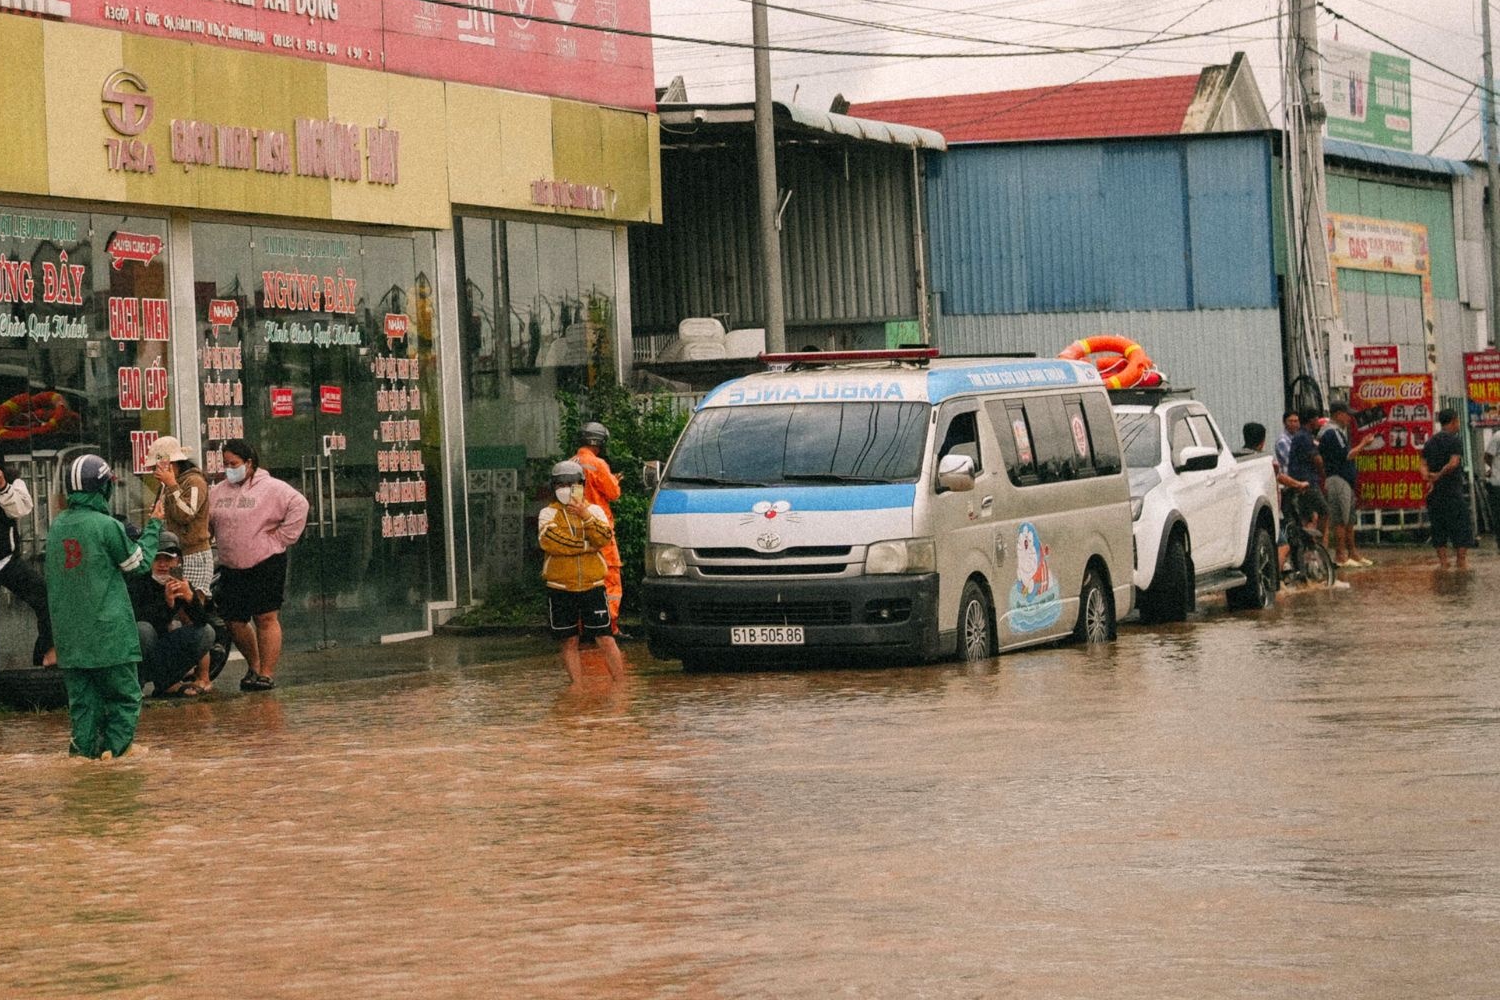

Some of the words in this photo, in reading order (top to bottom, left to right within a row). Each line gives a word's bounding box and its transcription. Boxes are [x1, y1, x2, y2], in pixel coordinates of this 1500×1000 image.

[104, 137, 156, 174] TASA
[1349, 237, 1368, 259] GAS
[42, 249, 85, 305] ĐÂY
[262, 267, 320, 311] NGƯNG
[323, 267, 357, 314] ĐÂY
[109, 297, 140, 352] GẠCH
[142, 298, 170, 341] MEN
[118, 366, 142, 410] CAO
[145, 355, 168, 410] CẤP
